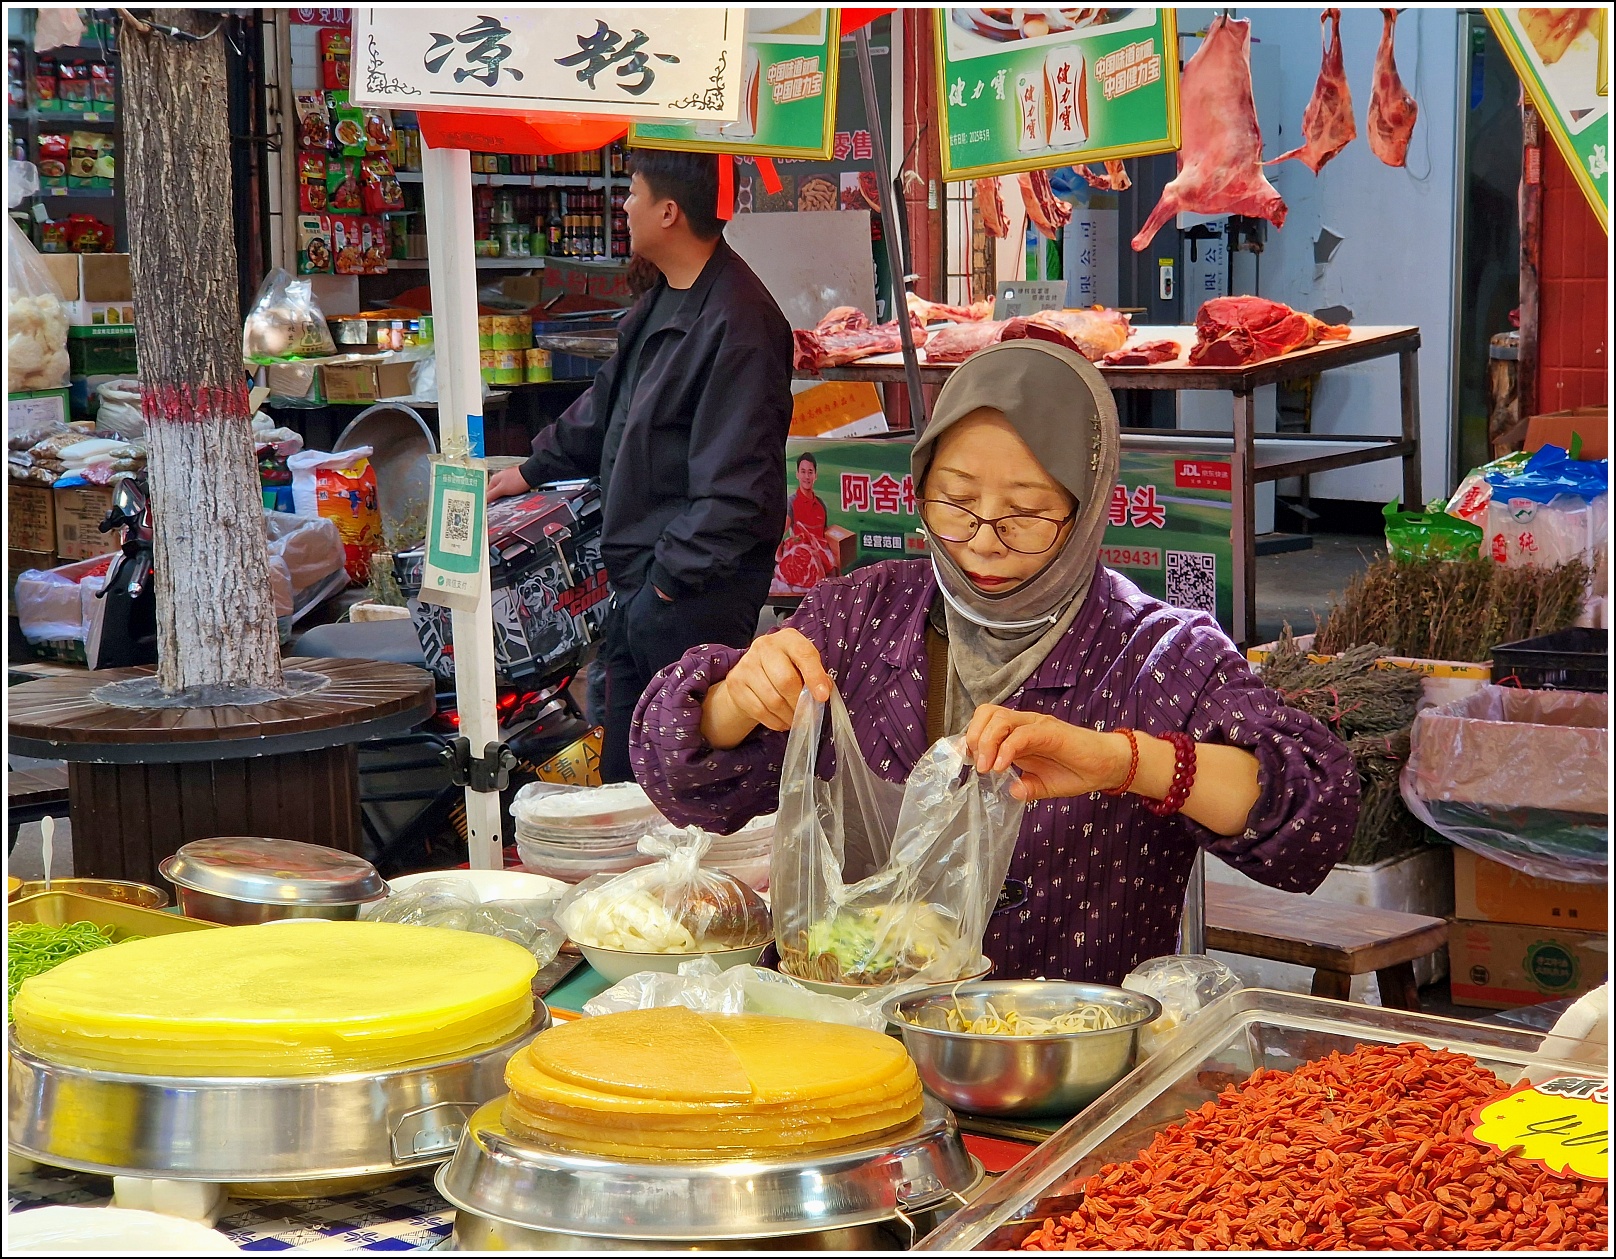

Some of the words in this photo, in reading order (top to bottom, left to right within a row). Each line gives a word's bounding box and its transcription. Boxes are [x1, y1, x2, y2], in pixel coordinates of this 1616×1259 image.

[424, 15, 680, 96] 凉粉
[773, 73, 823, 102] 中国健力宝
[1103, 57, 1160, 98] 中国健力宝
[1180, 464, 1200, 477] JDL
[863, 534, 902, 549] 经营范围
[553, 575, 597, 612] JUST
[570, 584, 610, 617] COOL
